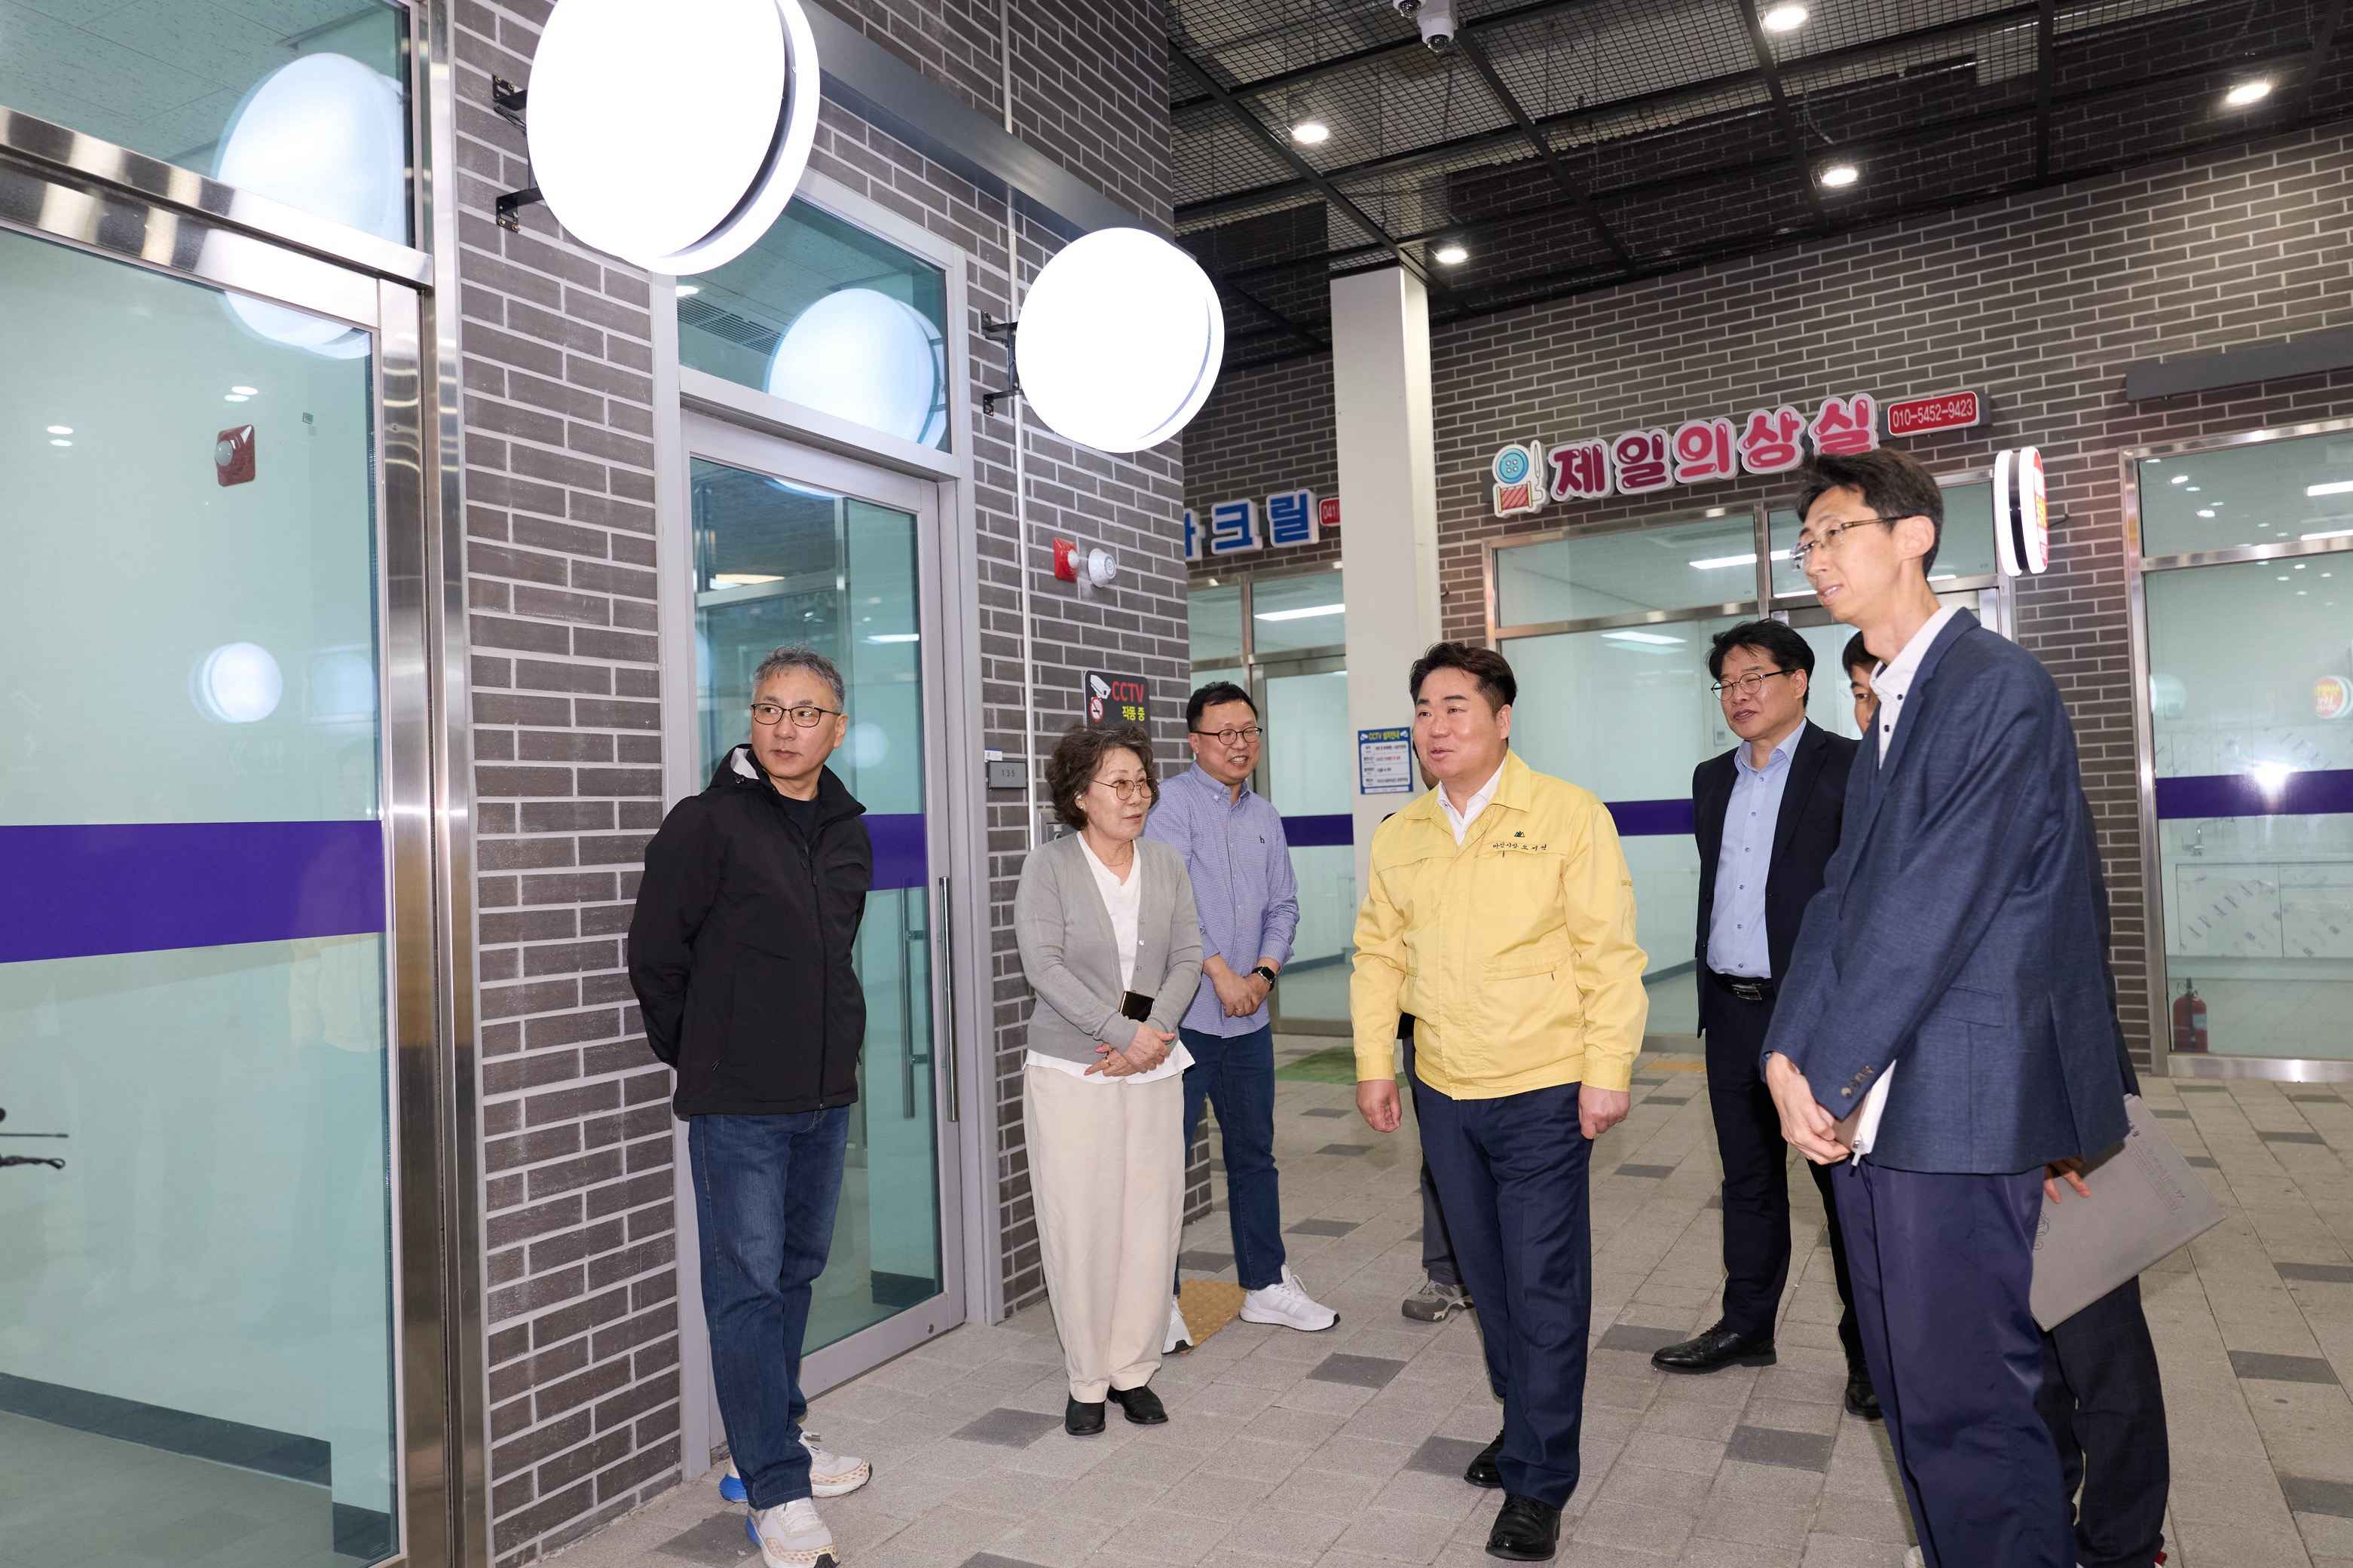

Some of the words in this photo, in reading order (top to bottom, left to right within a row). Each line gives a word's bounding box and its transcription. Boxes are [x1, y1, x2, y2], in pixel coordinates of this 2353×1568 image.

[1892, 399, 1973, 428] 010-5452-9423
[1553, 398, 1872, 497] 제일의상실
[1112, 681, 1144, 702] CCTV
[1122, 705, 1136, 721] 작동
[1137, 707, 1146, 722] 중
